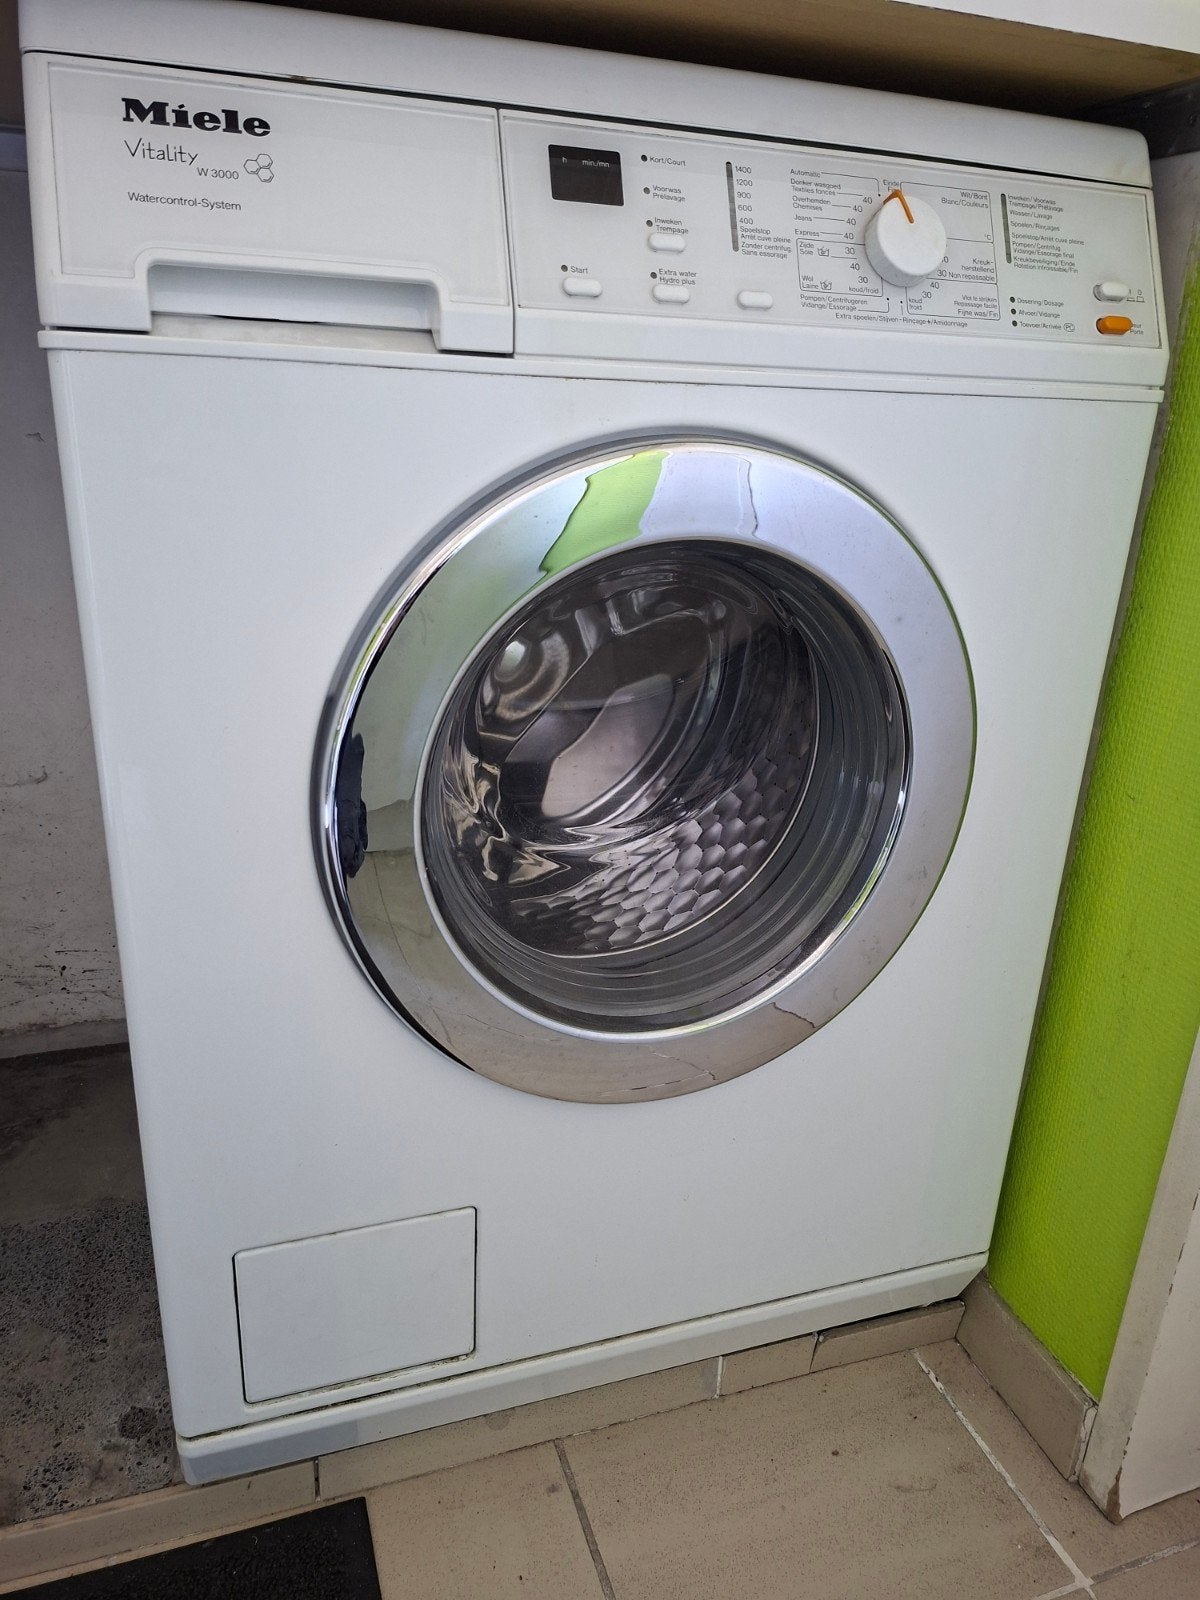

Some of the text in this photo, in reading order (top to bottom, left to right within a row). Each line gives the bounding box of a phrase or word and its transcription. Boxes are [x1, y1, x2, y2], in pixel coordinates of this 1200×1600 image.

[122, 98, 271, 137] Miele
[124, 138, 198, 165] Vitality
[650, 156, 686, 166] Kort/Court
[197, 168, 239, 179] W 3000
[735, 166, 752, 174] 1400
[790, 169, 820, 178] Automatic
[653, 185, 682, 194] Voorwas
[814, 181, 841, 189] wasgoed
[961, 192, 988, 200] Wit/Bont
[128, 192, 241, 210] Watercontrol-System
[792, 196, 862, 213] Overhemden 40
[863, 197, 872, 205] 40
[941, 198, 989, 209] Blanc/Couleurs
[793, 203, 823, 211] Chemises
[846, 218, 856, 226] 40
[656, 225, 689, 234] Trempage
[740, 226, 770, 235] Spoelstop
[795, 229, 854, 240] Express 40
[850, 263, 860, 271] 40
[659, 269, 677, 277] Extra
[660, 277, 696, 286] Hydro plus
[858, 276, 868, 284] 30
[849, 286, 879, 294] koud/froid
[922, 291, 932, 299] 30
